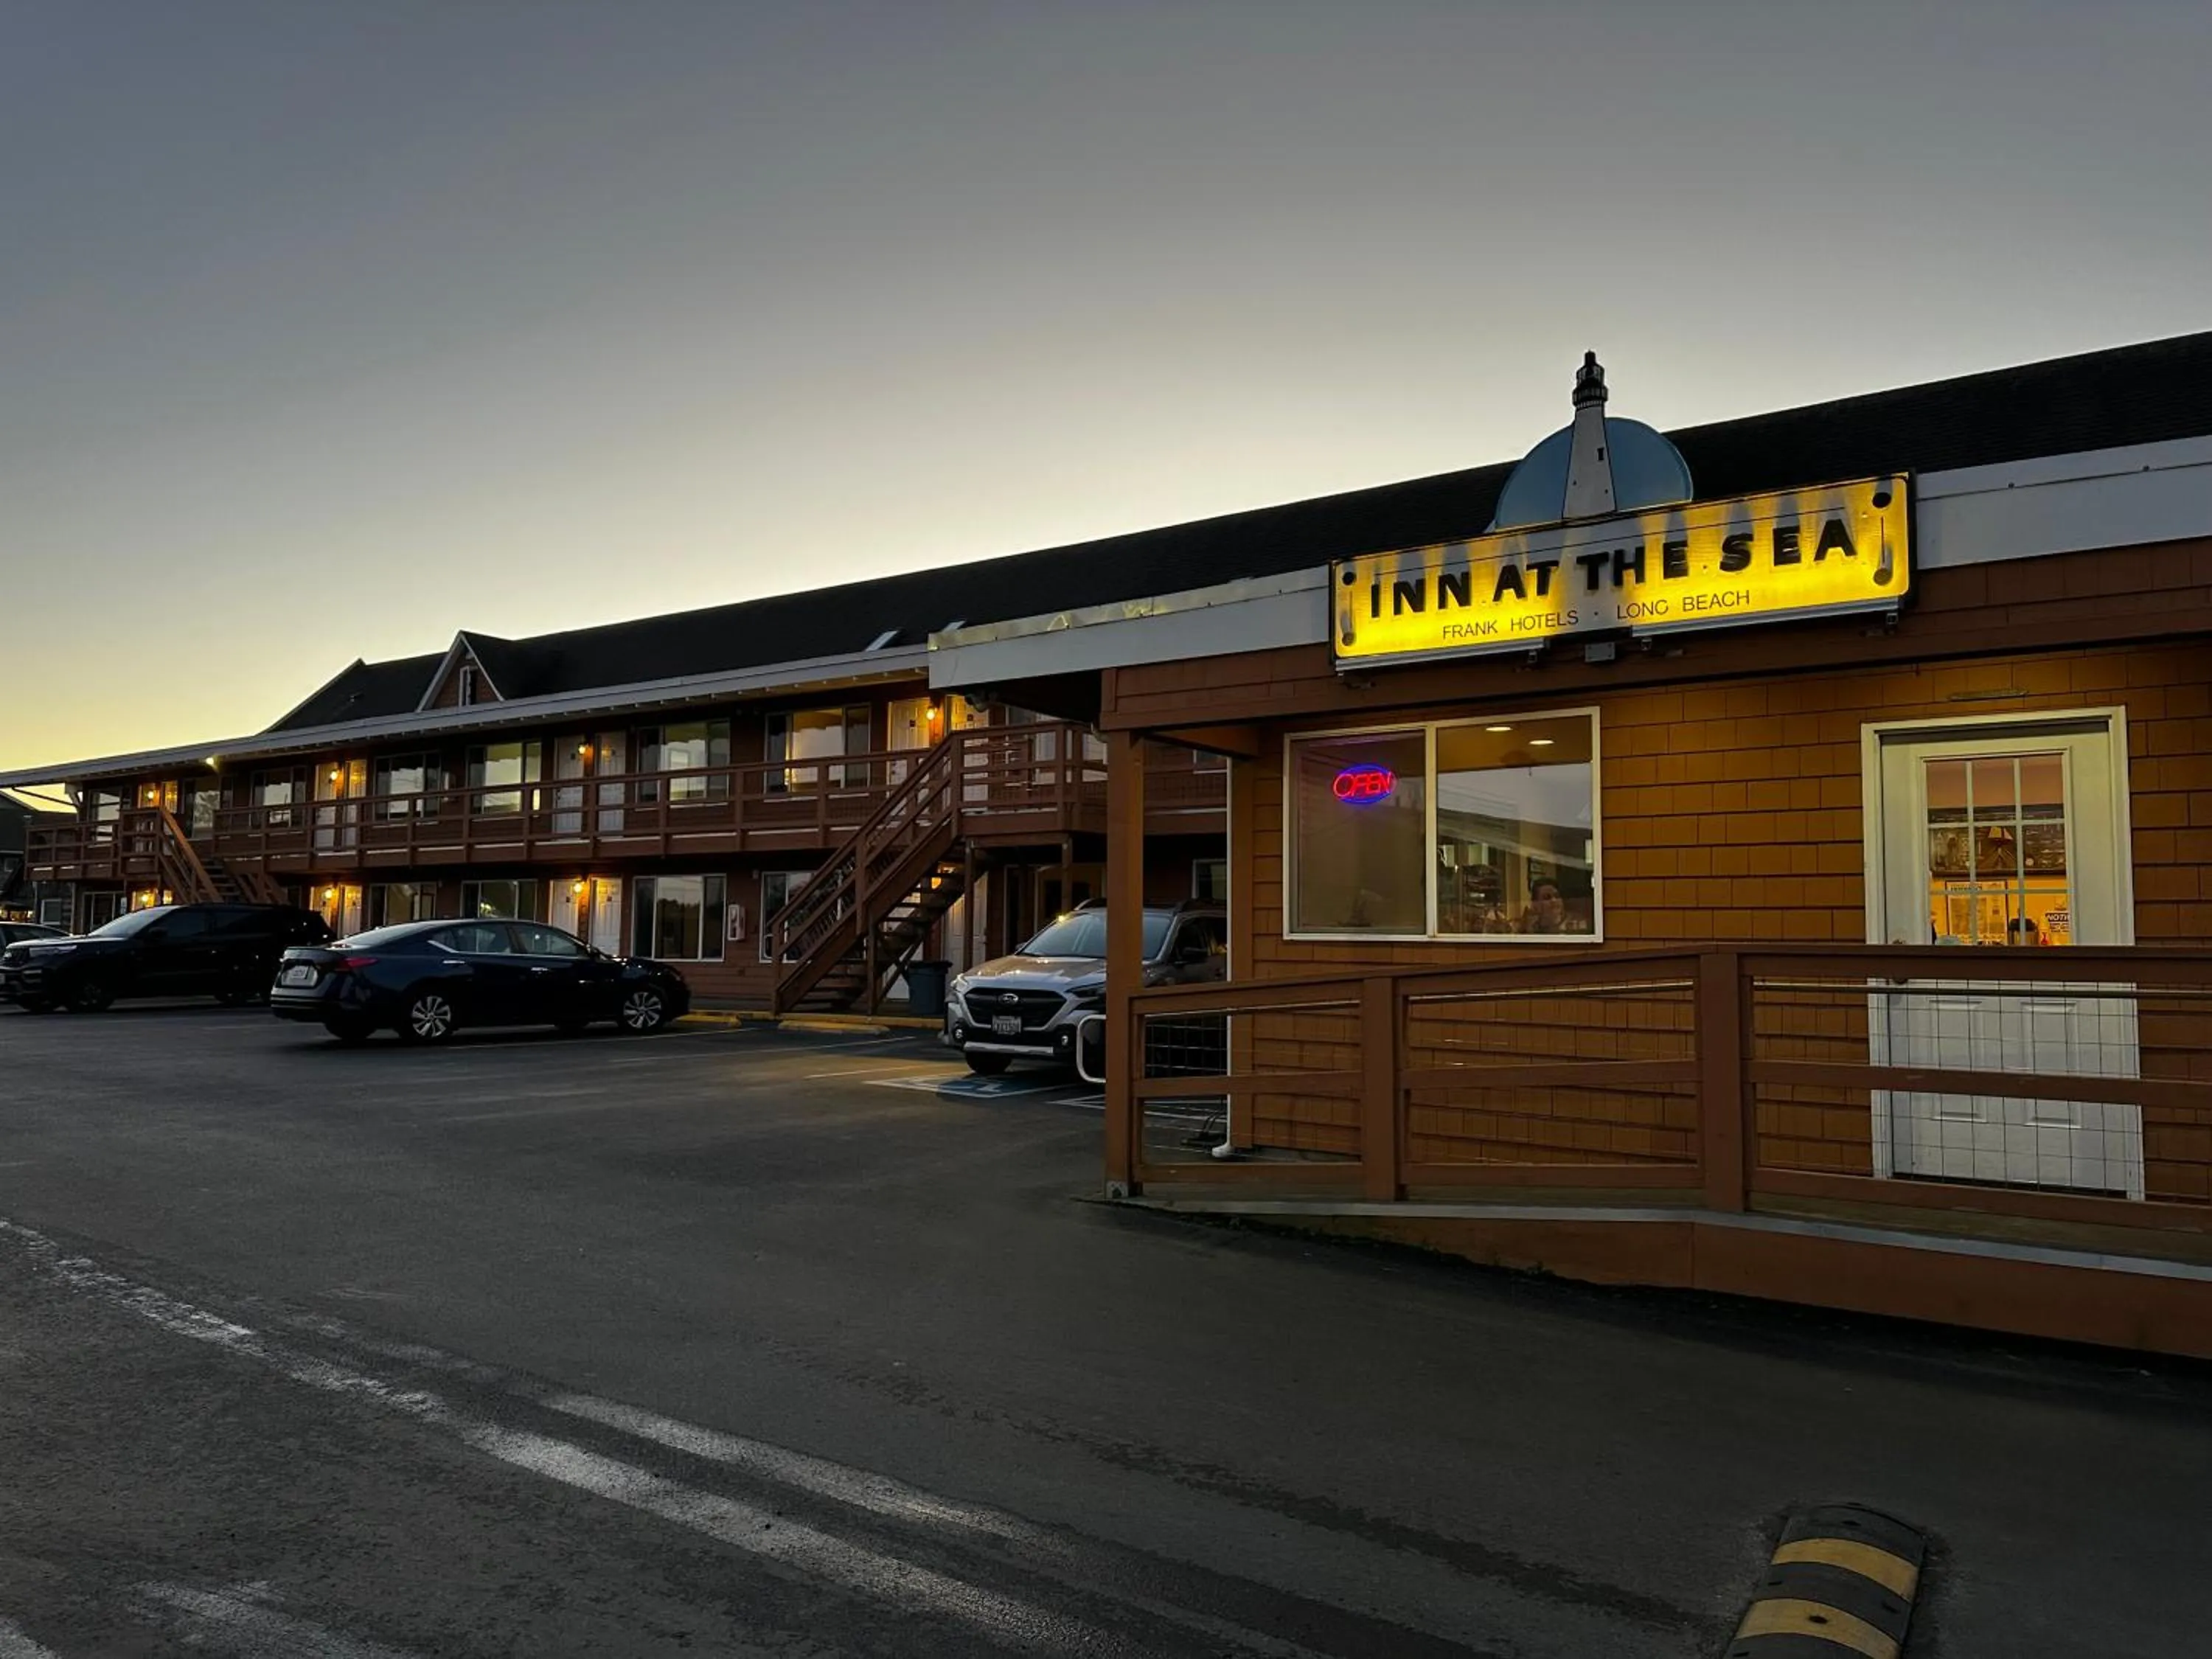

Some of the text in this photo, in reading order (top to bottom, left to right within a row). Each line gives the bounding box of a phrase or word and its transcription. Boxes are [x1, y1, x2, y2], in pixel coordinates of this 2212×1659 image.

[1371, 518, 1857, 618] INN AT THE SEA
[1442, 589, 1750, 639] FRANK HOTELS LONG BEACH
[1333, 772, 1391, 797] OPEN
